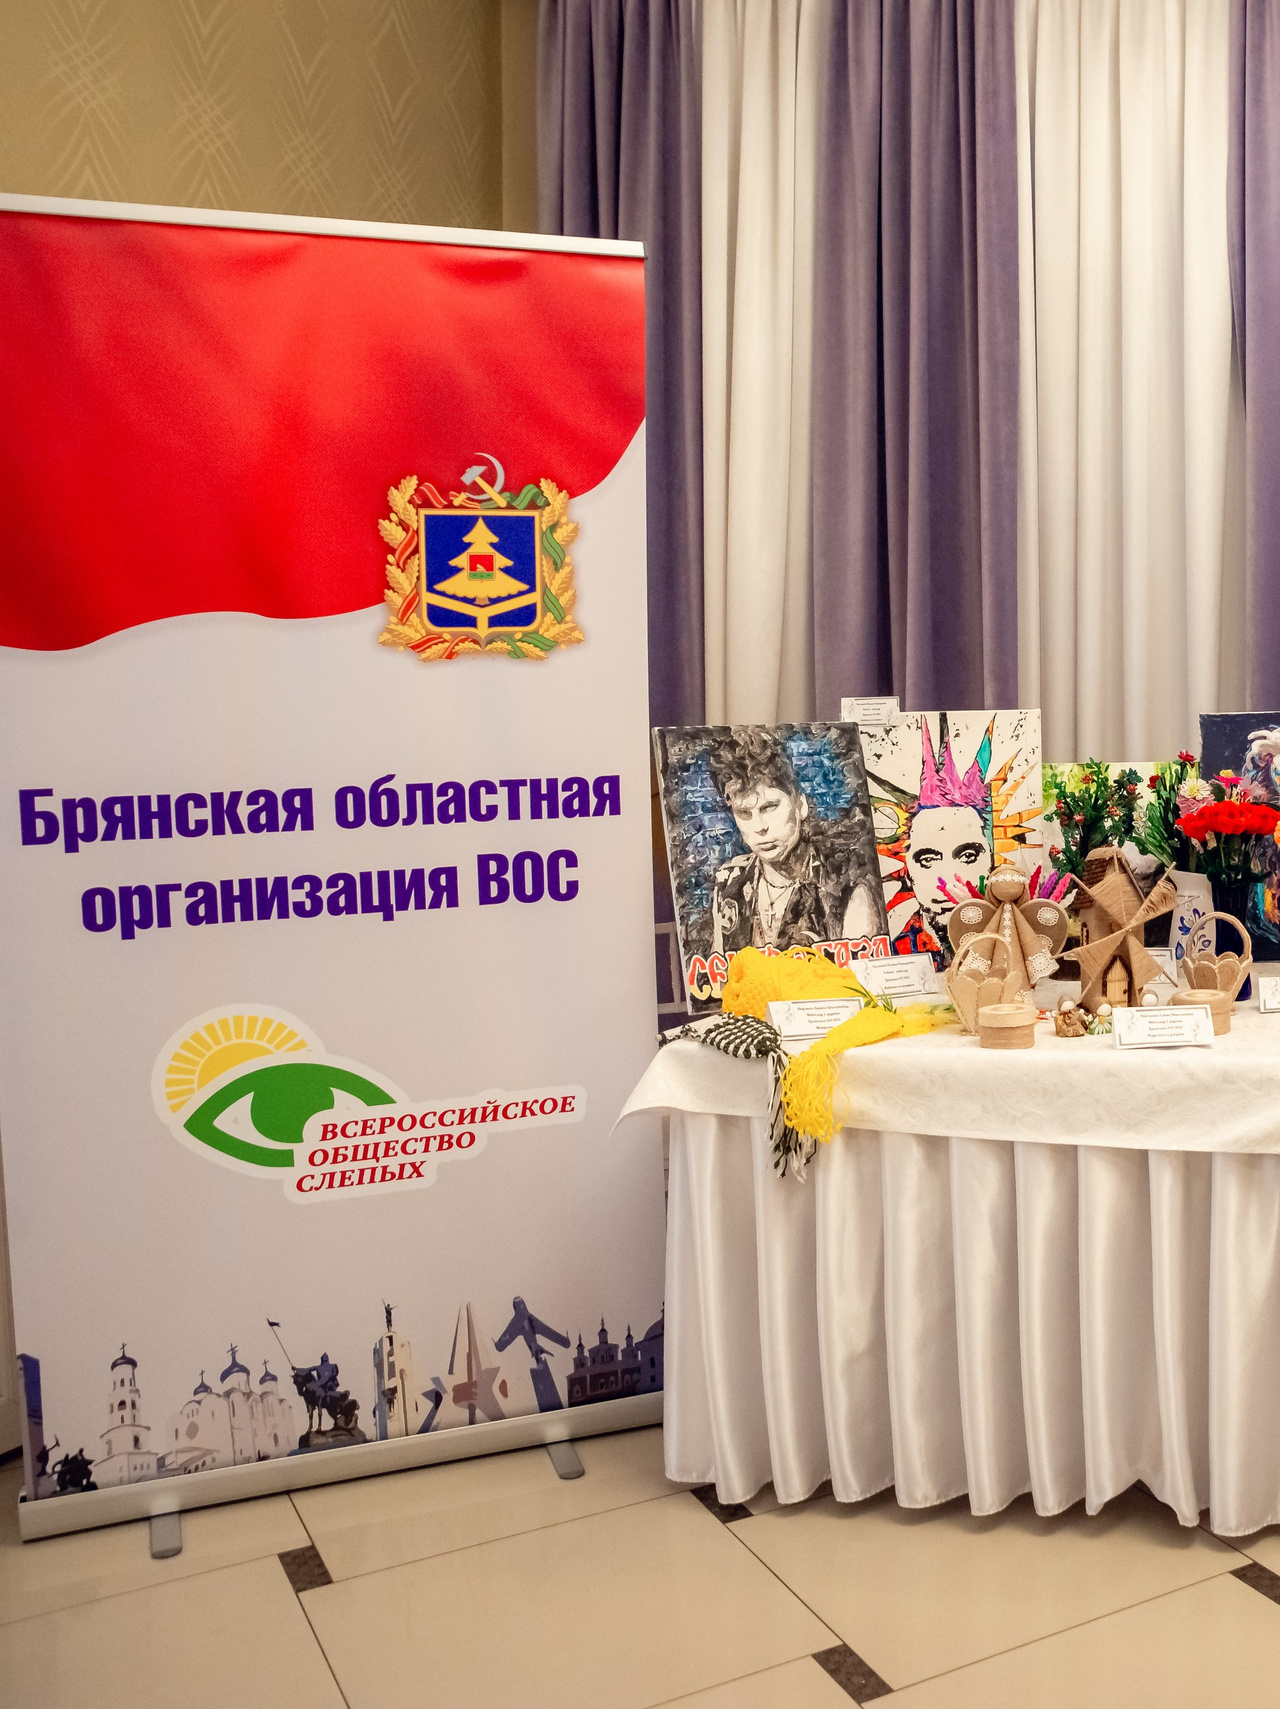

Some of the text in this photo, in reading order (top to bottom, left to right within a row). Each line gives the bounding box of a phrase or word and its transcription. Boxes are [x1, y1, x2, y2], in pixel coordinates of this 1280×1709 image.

[18, 774, 621, 854] Брянская областная
[80, 849, 579, 941] организация ВОС
[319, 1095, 577, 1142] ВСЕРОССИЙСКОЕ
[307, 1131, 476, 1168] ОБЩЕСТВО
[296, 1160, 425, 1193] СЛЕПЫХ
